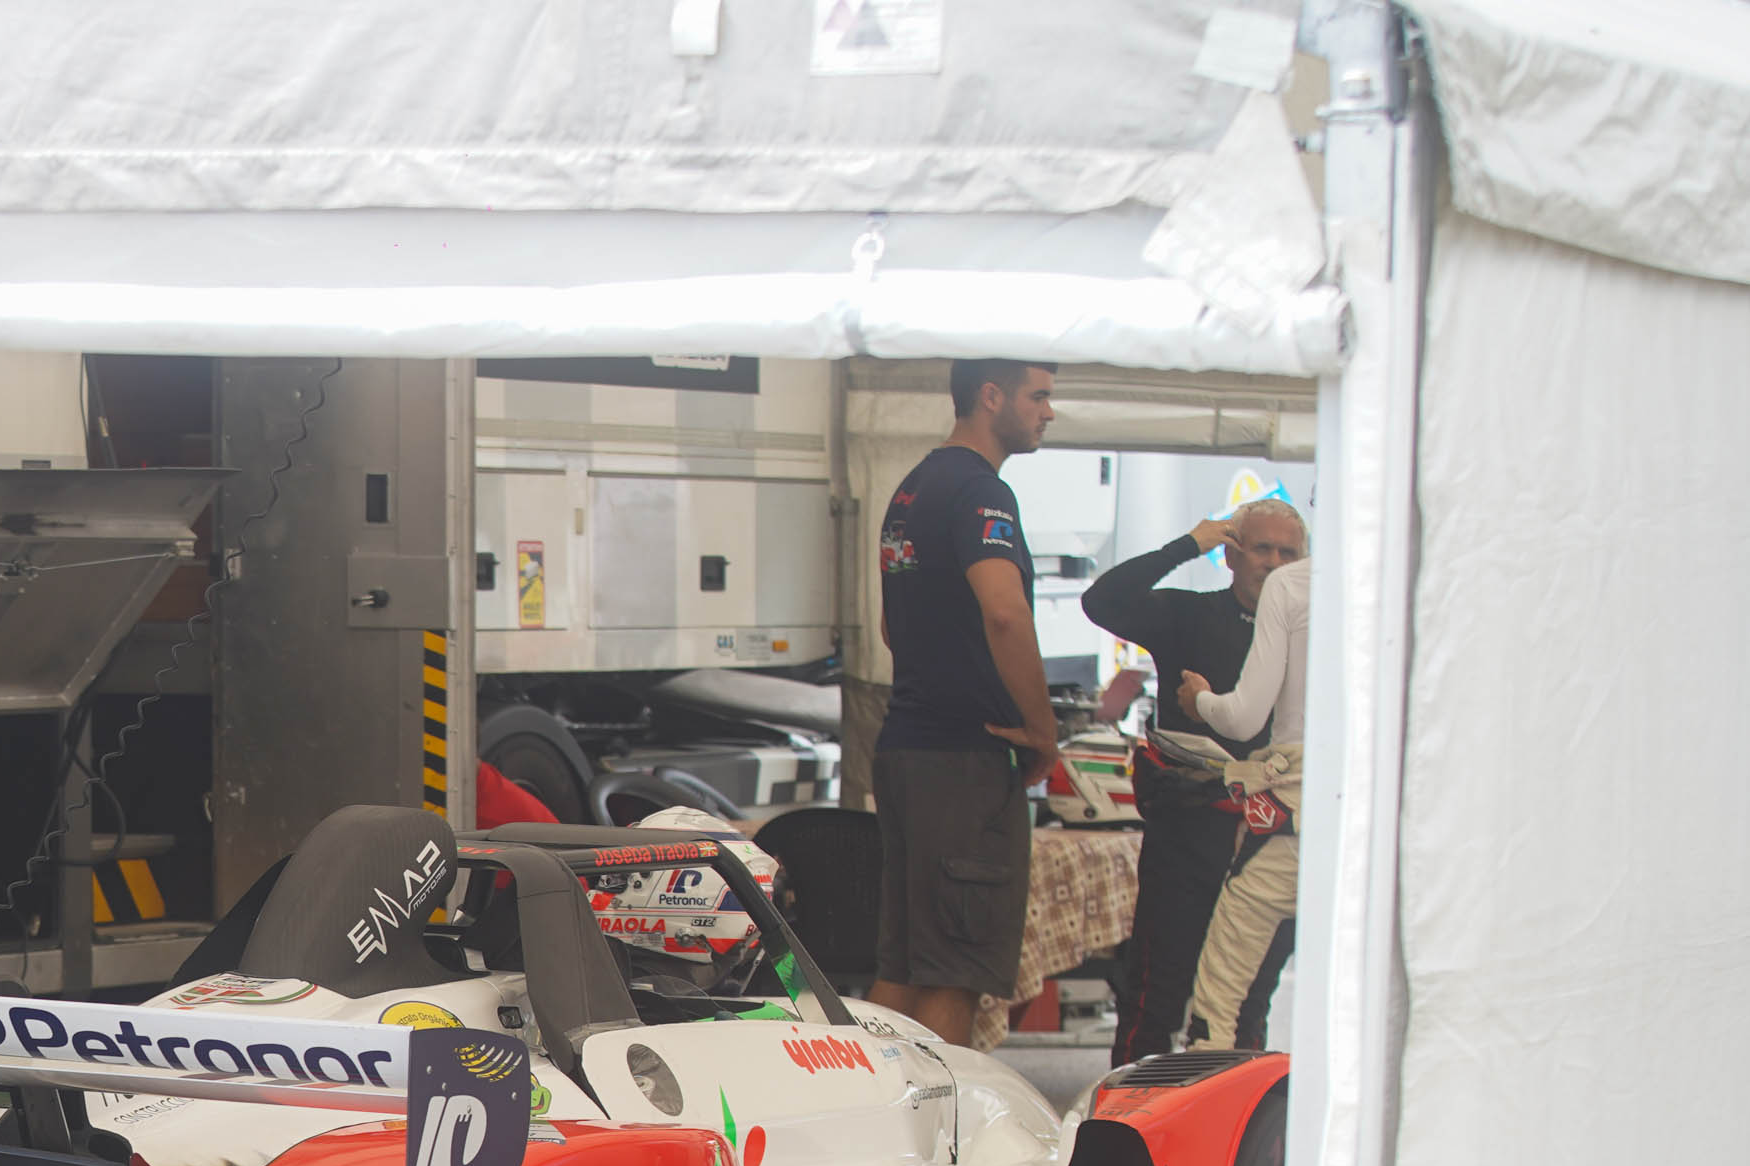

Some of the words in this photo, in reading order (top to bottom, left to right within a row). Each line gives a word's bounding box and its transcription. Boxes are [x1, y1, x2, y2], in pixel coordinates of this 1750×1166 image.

[595, 843, 651, 867] Joseba
[651, 841, 699, 863] Iraola
[412, 866, 447, 911] MOTORS
[658, 893, 709, 906] Petronor
[7, 1006, 392, 1089] Petronor
